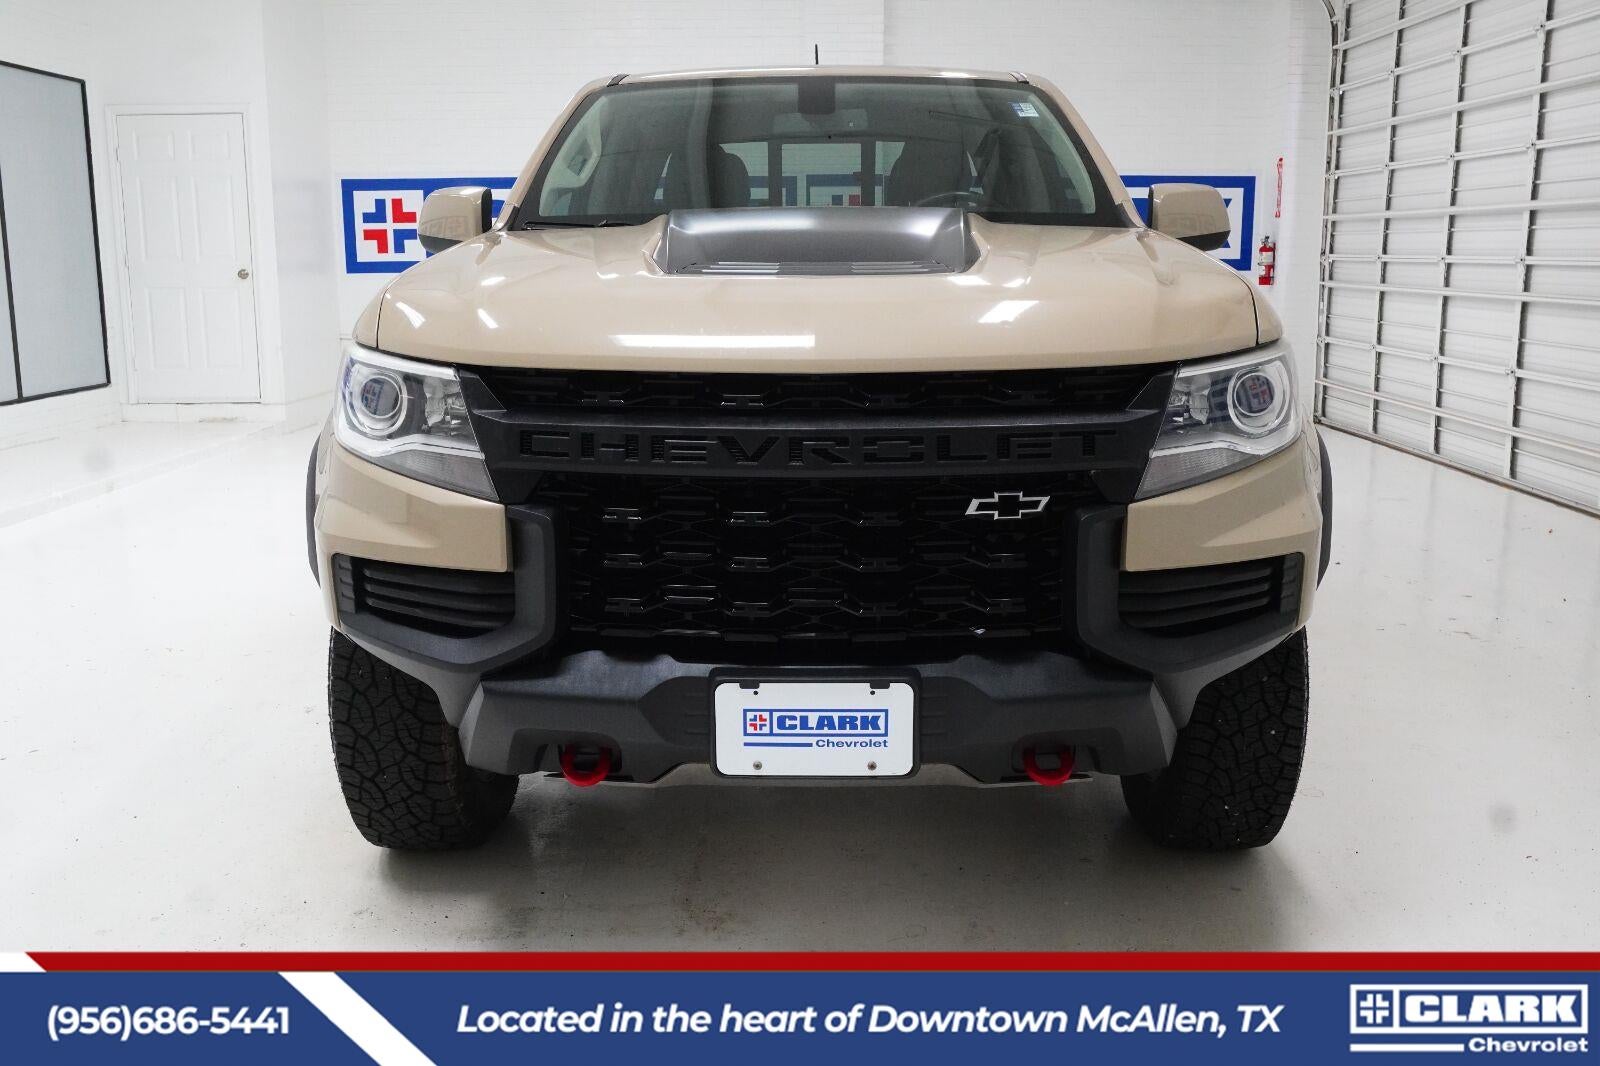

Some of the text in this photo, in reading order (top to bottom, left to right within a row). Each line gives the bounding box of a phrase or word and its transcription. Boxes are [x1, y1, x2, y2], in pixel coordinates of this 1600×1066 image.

[519, 429, 1117, 465] CHEVROLET
[776, 714, 882, 731] CLARK
[815, 738, 889, 749] Chevrolet
